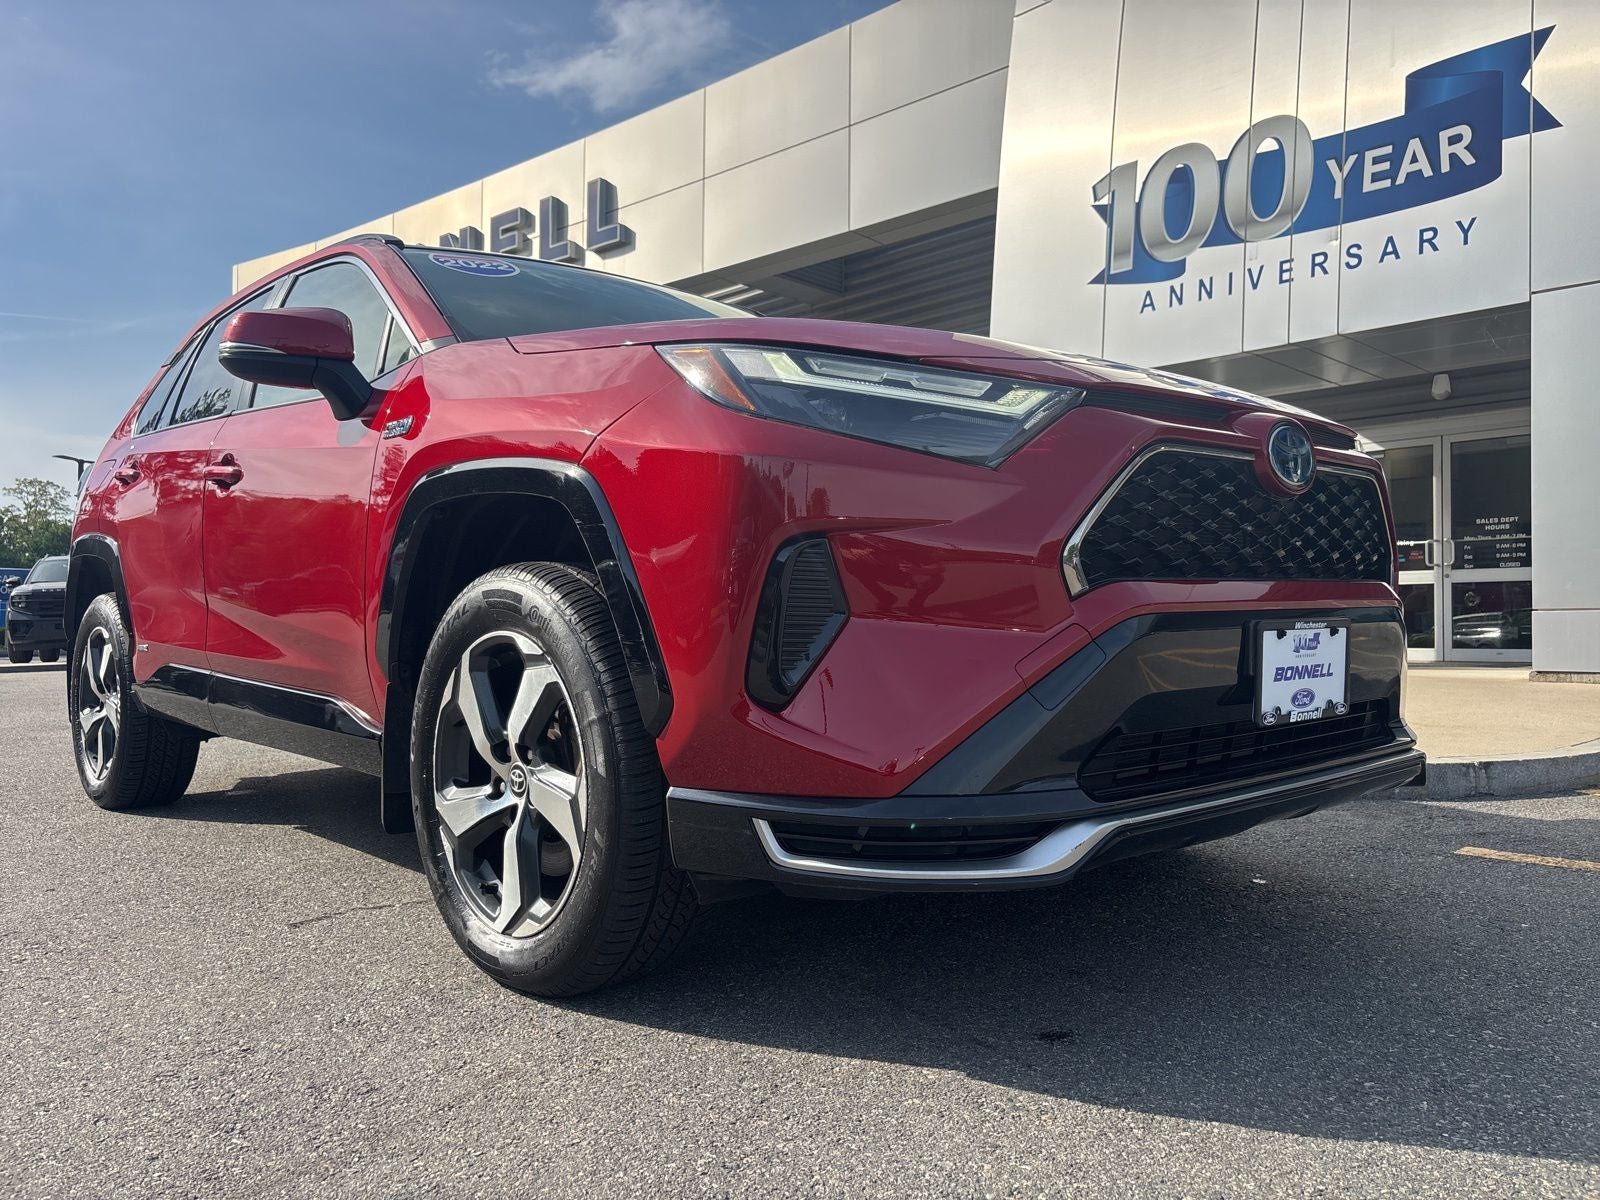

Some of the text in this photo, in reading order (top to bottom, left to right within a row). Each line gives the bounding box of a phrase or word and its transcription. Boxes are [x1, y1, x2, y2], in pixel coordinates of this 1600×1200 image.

[1092, 114, 1477, 275] 100 YEAR
[441, 257, 512, 270] 2022
[1140, 216, 1478, 314] ANNIVERSARY
[1294, 621, 1327, 629] Winchester
[1273, 662, 1333, 682] BONNELL
[1294, 691, 1312, 705] Ford
[1289, 707, 1323, 722] Bonnell
